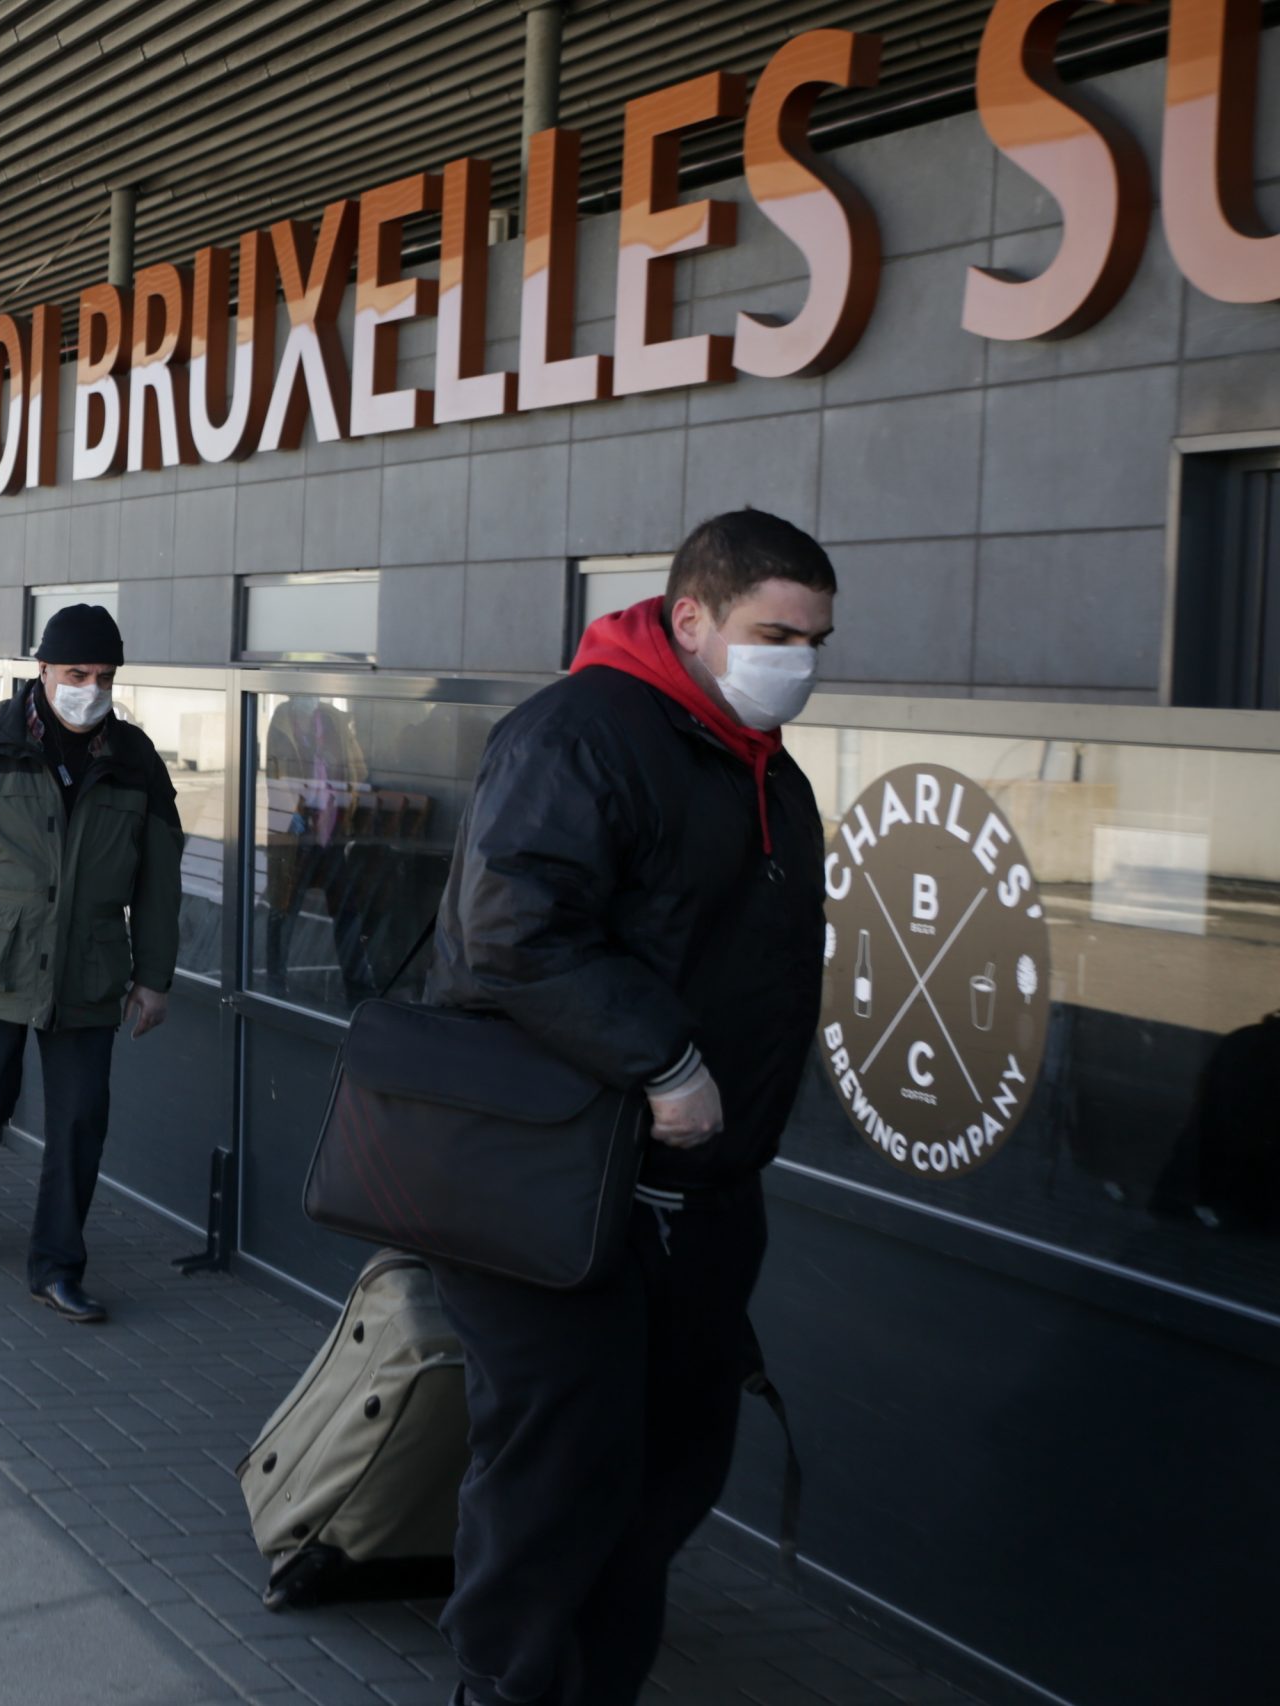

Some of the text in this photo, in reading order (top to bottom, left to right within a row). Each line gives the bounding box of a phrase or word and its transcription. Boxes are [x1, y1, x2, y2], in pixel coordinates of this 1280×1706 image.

[72, 28, 878, 480] BRUXELLES
[911, 872, 940, 922] B
[824, 1022, 1028, 1174] BREWING COMPANY
[906, 1040, 936, 1088] C
